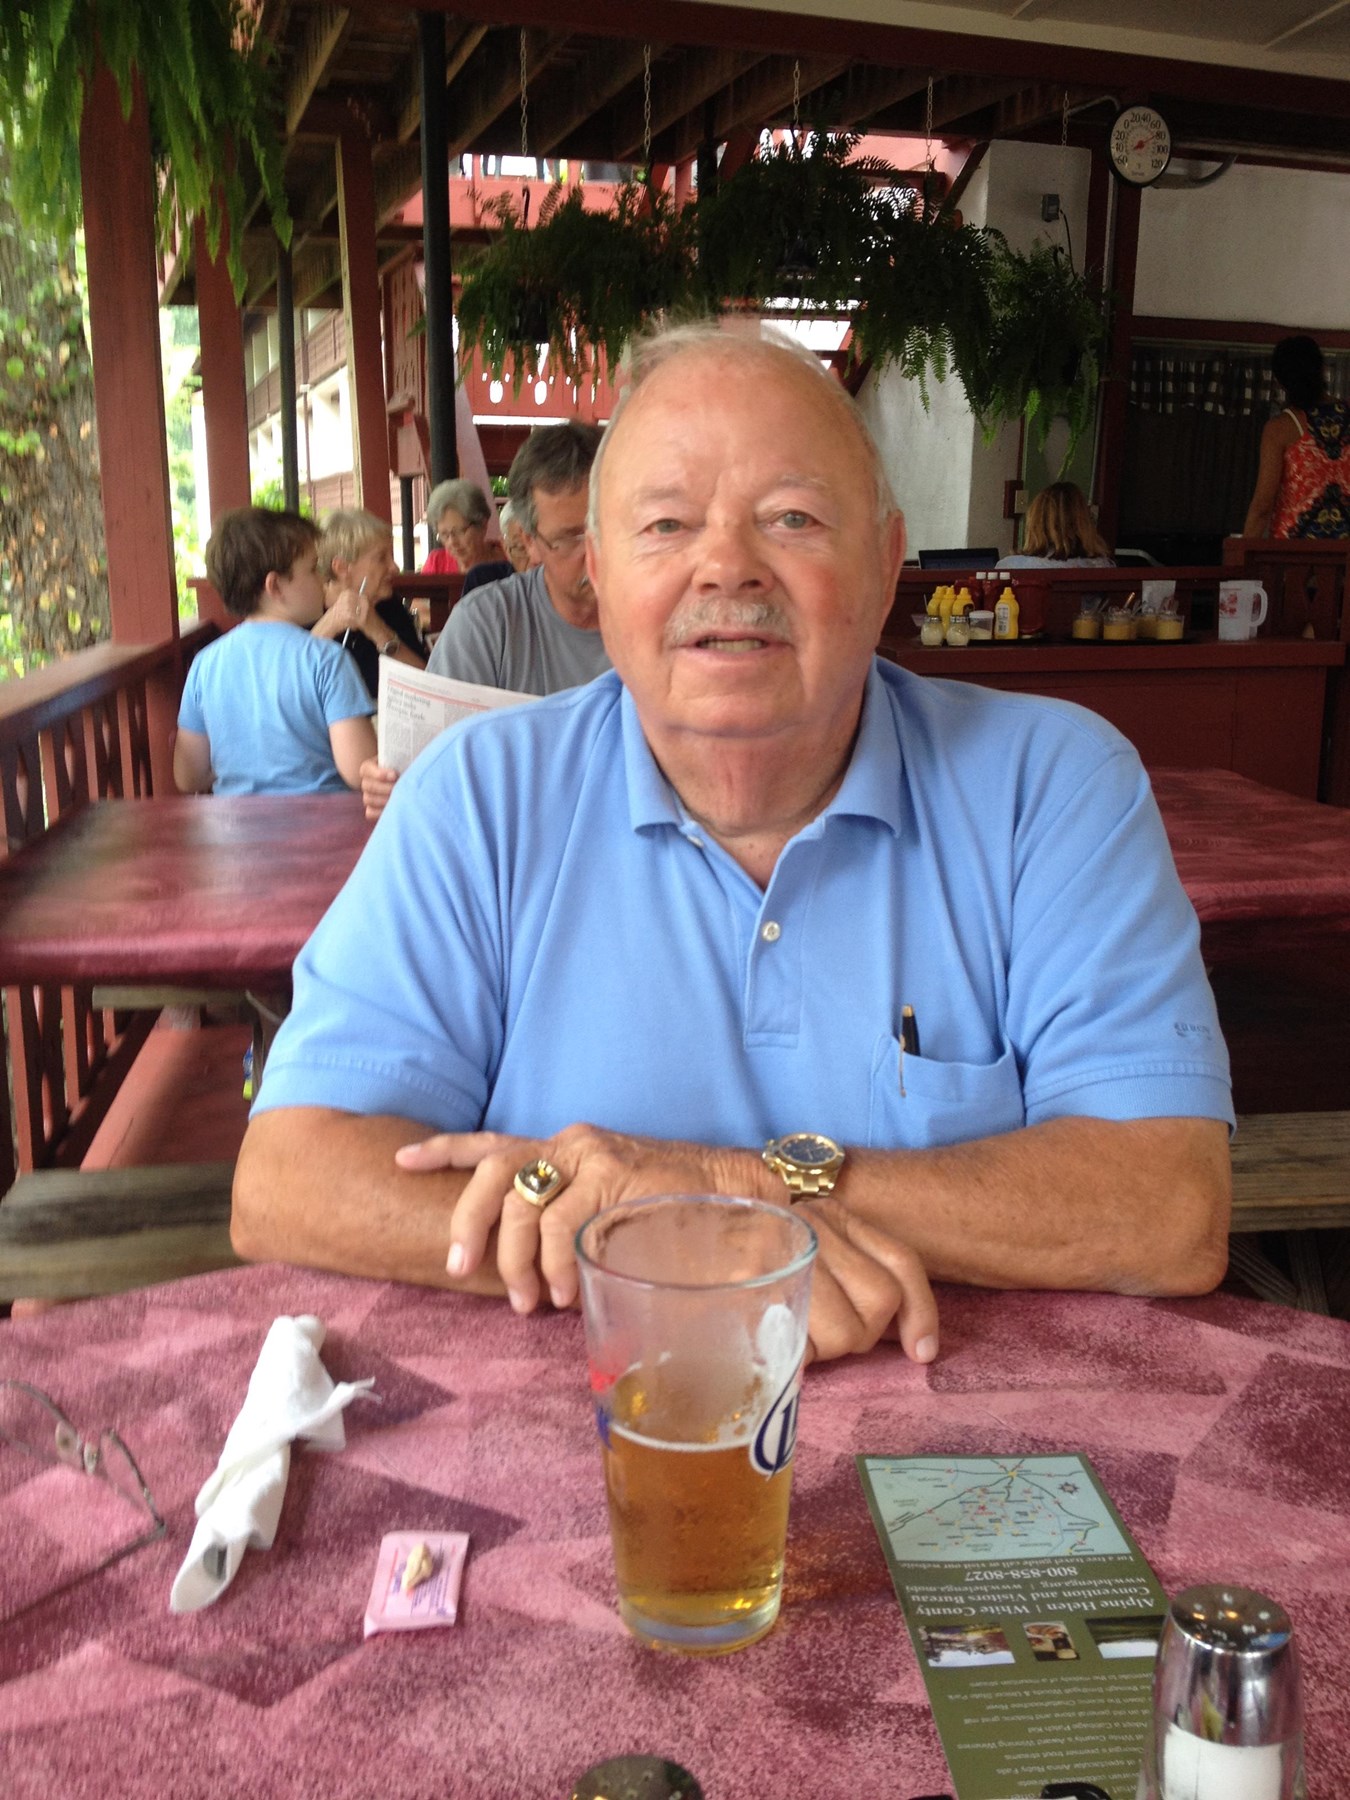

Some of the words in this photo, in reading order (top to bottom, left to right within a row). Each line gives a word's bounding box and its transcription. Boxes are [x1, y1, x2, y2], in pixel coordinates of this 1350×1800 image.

[1130, 112, 1140, 123] 20
[1141, 112, 1151, 122] 40
[1124, 119, 1130, 129] 0
[1150, 120, 1161, 129] 60
[1155, 131, 1167, 140] 80
[1156, 145, 1168, 154] 100
[1151, 159, 1163, 169] 120
[963, 1562, 987, 1570] visit
[1001, 1560, 1020, 1568] call
[1022, 1557, 1052, 1567] guide
[1053, 1557, 1085, 1565] travel
[963, 1565, 1079, 1582] 800-858-8027
[1039, 1576, 1147, 1590] www.helenga.org
[905, 1583, 1023, 1594] www.helenga.mobi
[1061, 1585, 1150, 1599] Convention
[910, 1594, 966, 1605] Bureau
[967, 1592, 1027, 1604] Visitors
[1030, 1591, 1058, 1601] and
[1045, 1601, 1097, 1613] Helen
[1099, 1595, 1155, 1610] Alpine
[915, 1604, 977, 1617] County
[979, 1604, 1030, 1616] White
